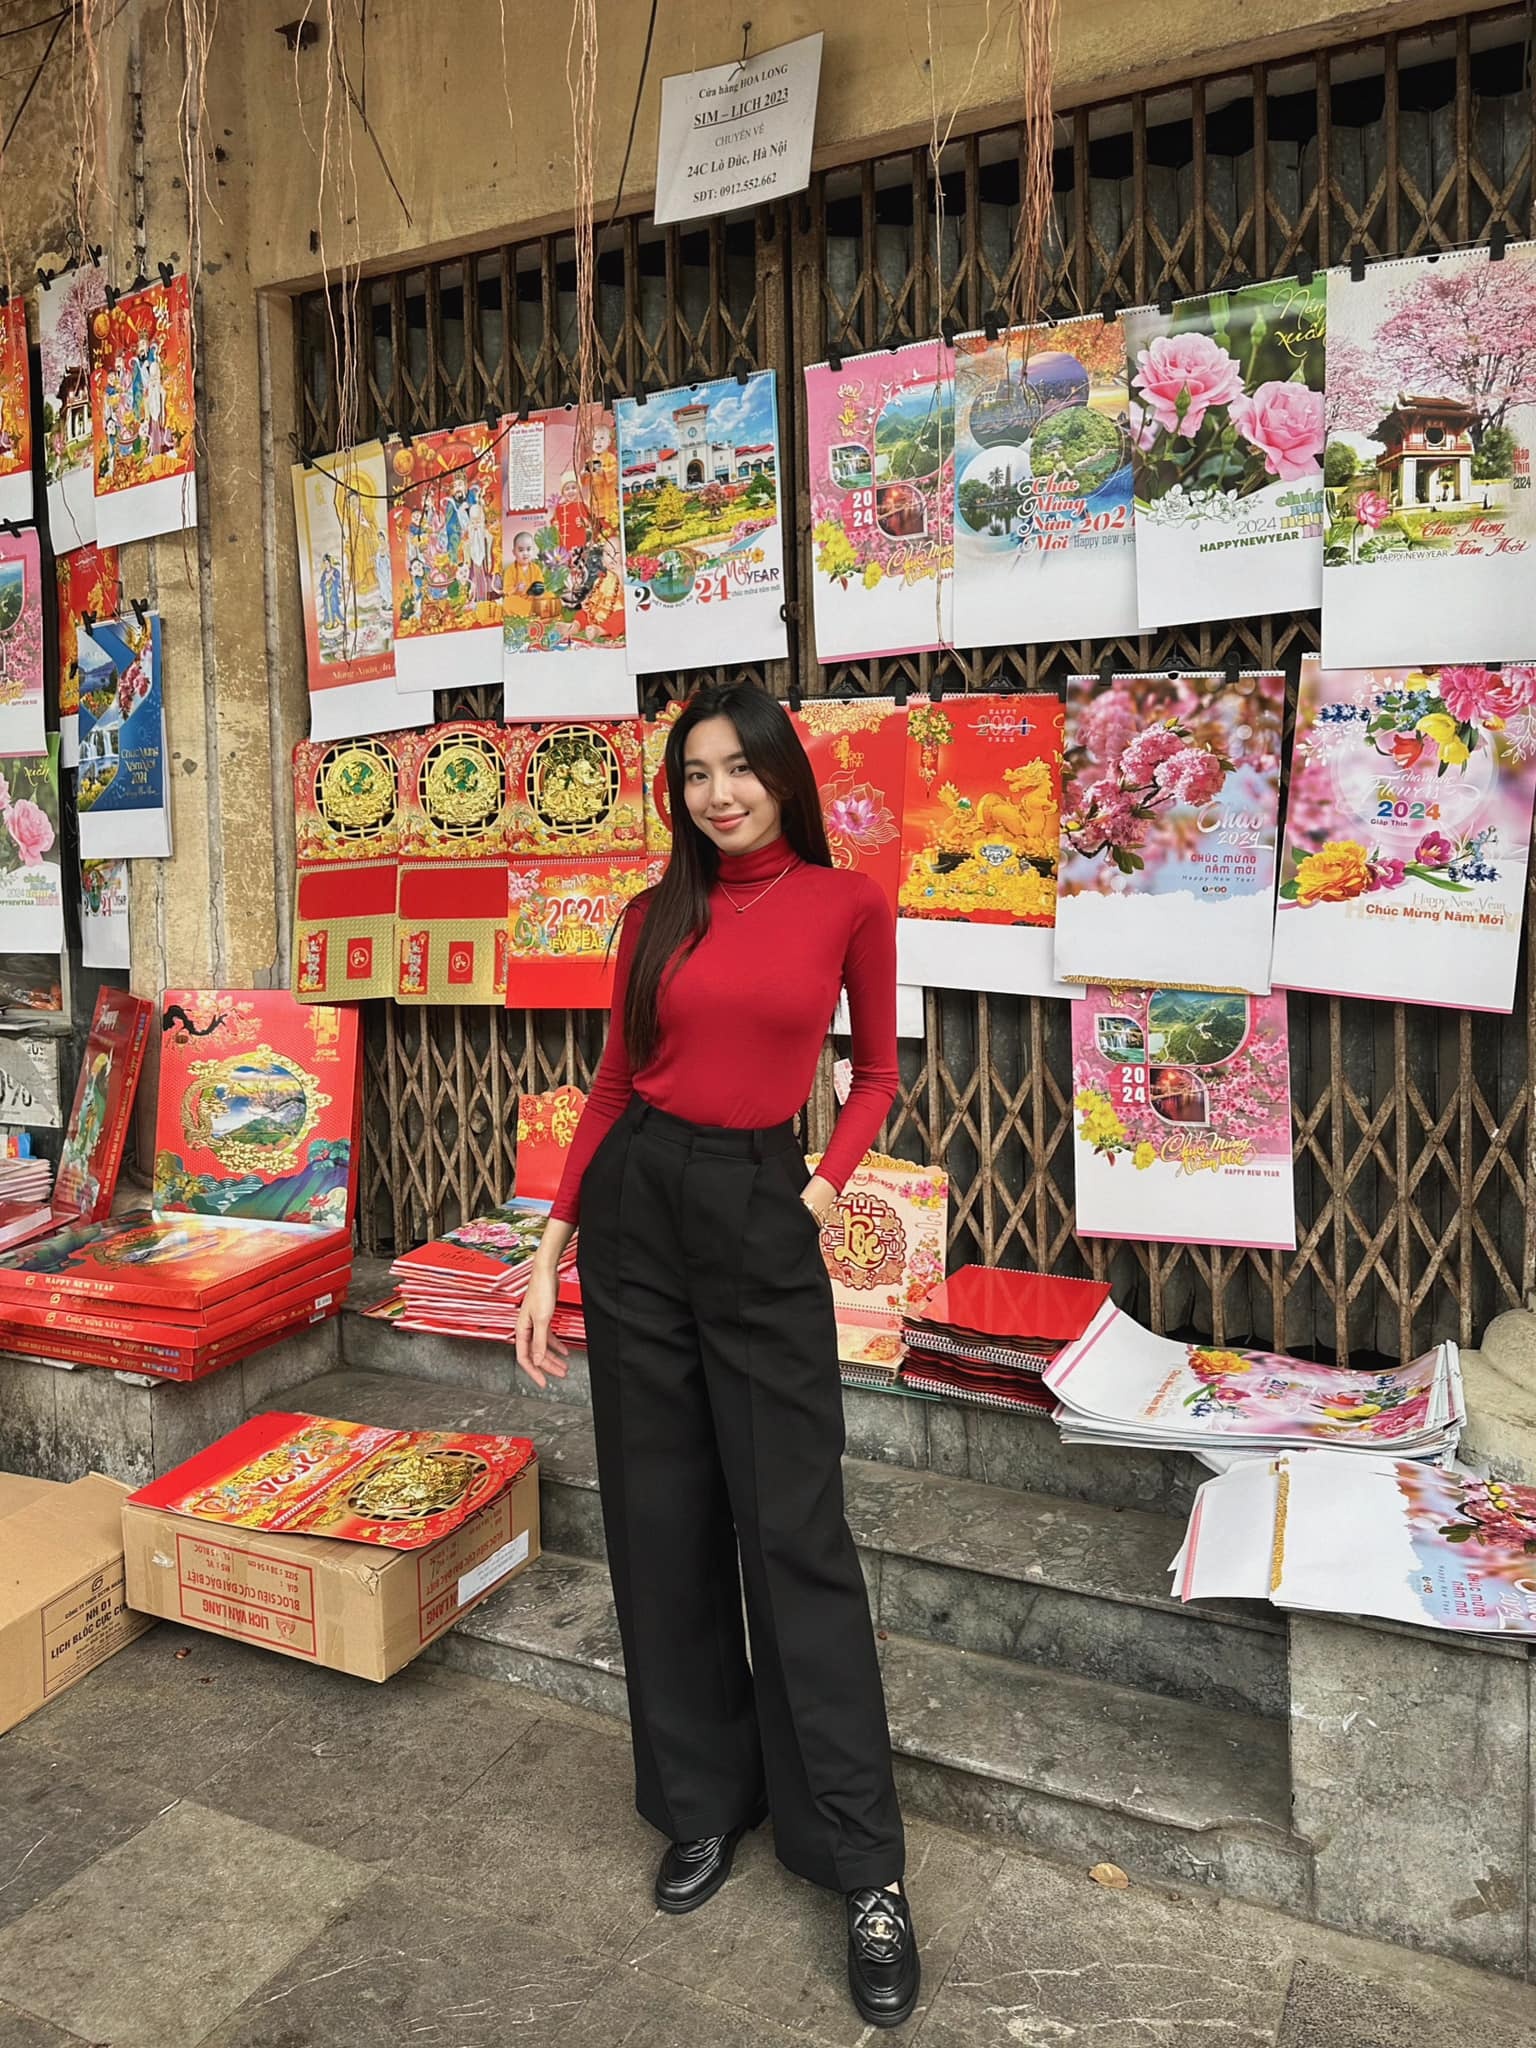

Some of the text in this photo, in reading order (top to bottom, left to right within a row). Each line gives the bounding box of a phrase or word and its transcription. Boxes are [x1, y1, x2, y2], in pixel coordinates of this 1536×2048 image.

[761, 64, 788, 81] LONG
[693, 110, 718, 126] SIM
[764, 87, 788, 107] 2023
[687, 162, 708, 178] 24C
[752, 146, 767, 162] Hà
[770, 139, 788, 157] Nội
[719, 172, 777, 198] 0912.552.662
[1512, 475, 1532, 489] 2024
[852, 489, 873, 509] 20
[852, 508, 874, 527] 24
[1236, 516, 1277, 535] 2024
[1073, 534, 1100, 549] Happy
[1123, 533, 1136, 544] yea
[1199, 531, 1300, 553] HAPPYNEWYEAR
[1405, 551, 1425, 560] NEW
[1427, 549, 1449, 559] YEAR
[1377, 800, 1441, 821] 2024
[1217, 831, 1261, 848] 2024
[546, 896, 607, 932] 2024
[1366, 903, 1399, 916] Chúc
[1402, 905, 1440, 921] Mừng
[1444, 910, 1475, 923] Năm
[1478, 911, 1504, 925] Mới
[1122, 1066, 1145, 1084] 20
[1122, 1086, 1146, 1103] 24
[1224, 1168, 1280, 1178] HAPPY NEW YEAR
[45, 1277, 70, 1287] HAPPY
[73, 1280, 91, 1290] NEW
[94, 1283, 116, 1292] YEAR
[194, 1544, 209, 1555] BLOC
[284, 1571, 299, 1581] SIZE
[187, 1569, 300, 1611] BLOC SIÊU CỰC ĐẠI ĐẶC BIỆT
[85, 1598, 112, 1622] NH 01
[202, 1599, 269, 1630] LỊCH VĂN LANG
[426, 1597, 448, 1625] LANG
[51, 1640, 71, 1659] LỊCH
